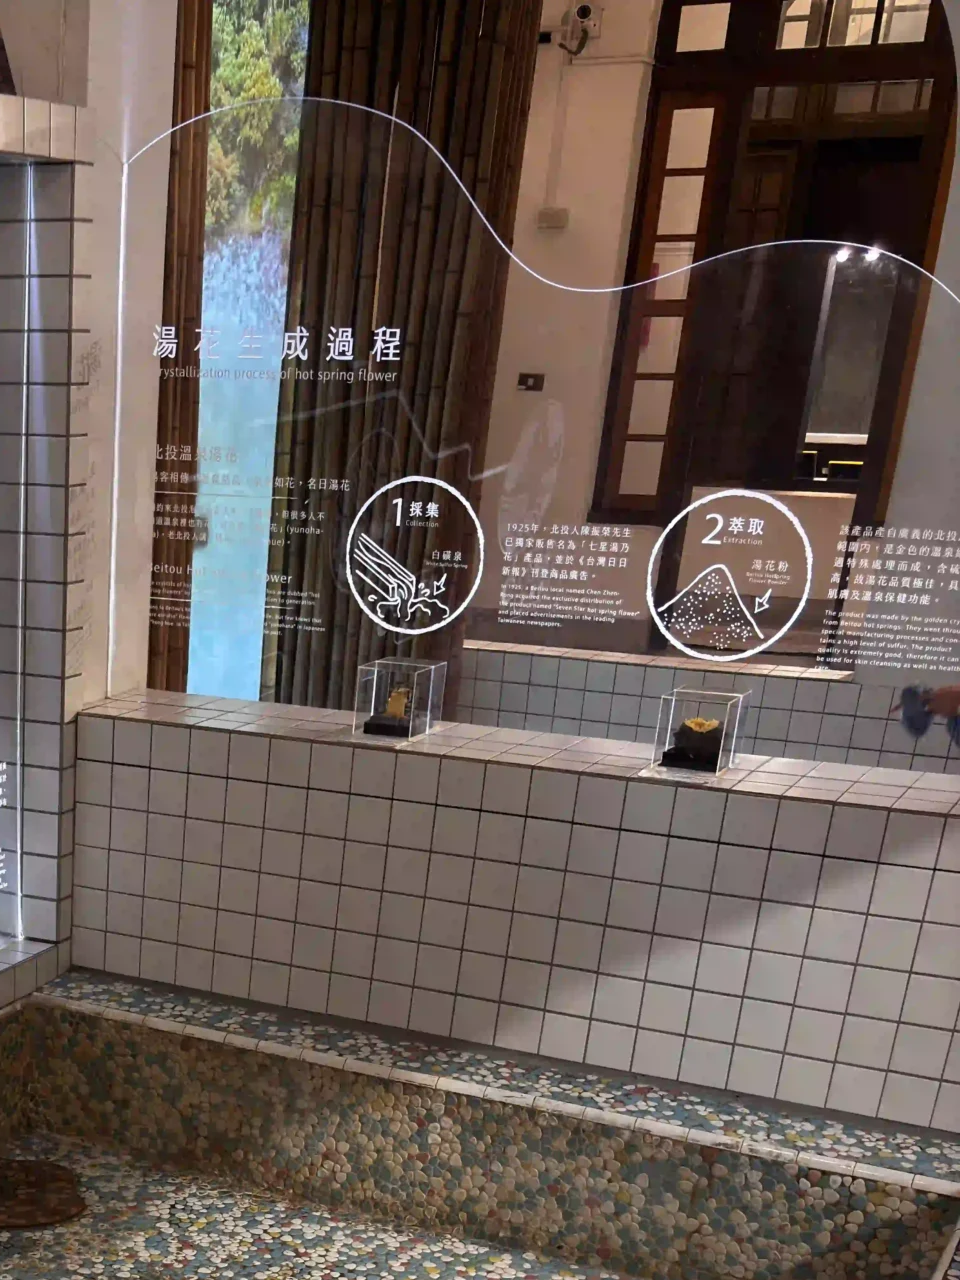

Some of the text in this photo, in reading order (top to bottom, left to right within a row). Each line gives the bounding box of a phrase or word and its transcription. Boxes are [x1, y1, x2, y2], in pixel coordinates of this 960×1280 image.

[158, 366, 231, 379] rystallization
[280, 369, 292, 380] of
[295, 369, 314, 381] hot
[317, 369, 355, 384] spring
[358, 370, 397, 382] flower
[391, 496, 439, 527] 1 採集
[404, 519, 439, 528] Collection
[700, 512, 764, 545] 2 萃取
[722, 535, 763, 545] Extraction
[579, 596, 615, 605] distribution
[573, 605, 586, 613] Star
[598, 608, 617, 617] spring
[497, 617, 526, 625] Taiwanese
[530, 611, 574, 620] advertisements
[593, 616, 616, 624] leading
[876, 623, 902, 631] springs.
[905, 624, 922, 633] They
[846, 631, 894, 640] manufacturing
[843, 639, 859, 647] high
[849, 649, 938, 661] extremely therefore
[869, 659, 901, 669] cleansing
